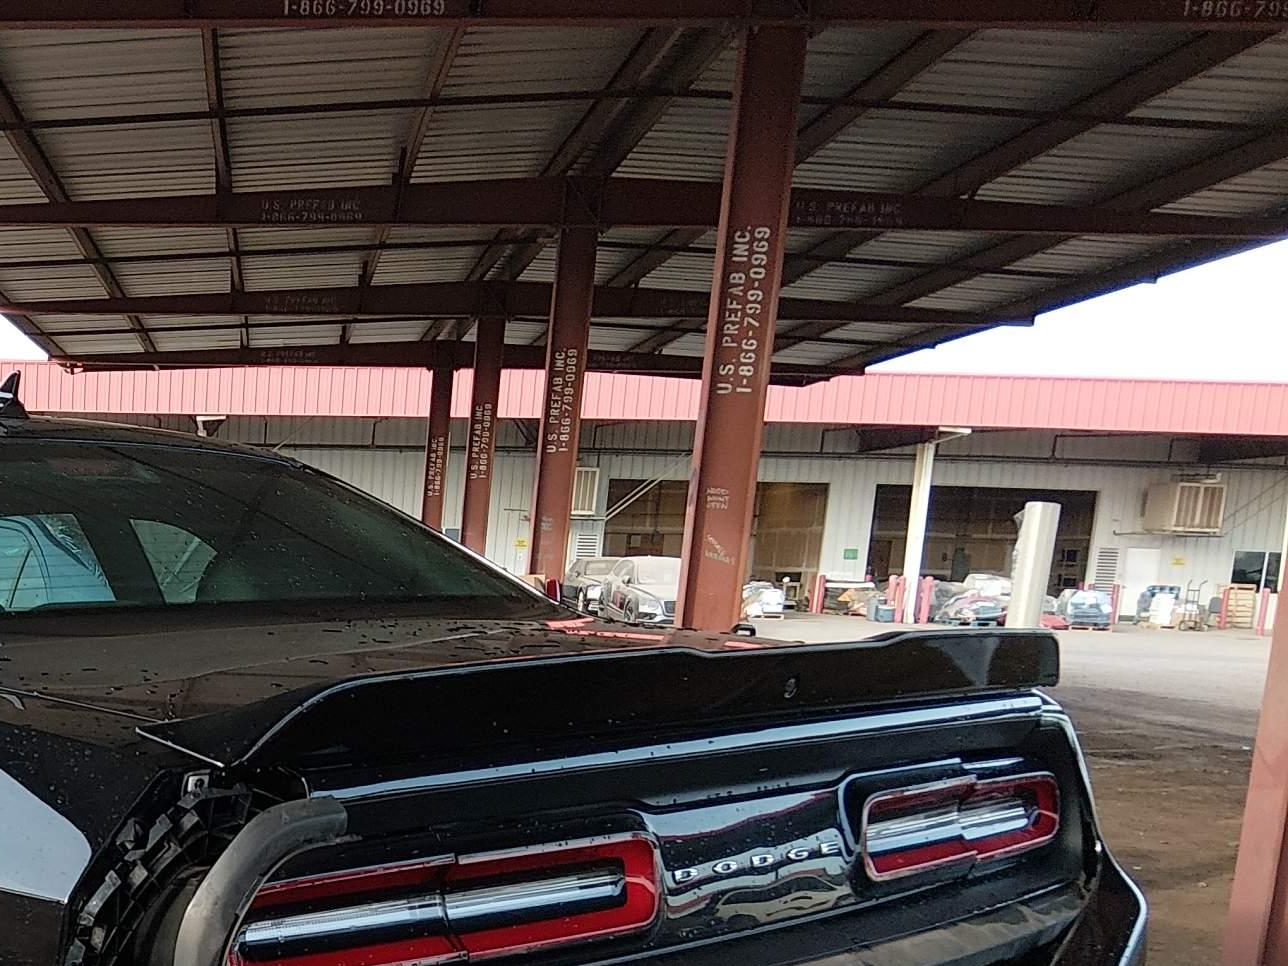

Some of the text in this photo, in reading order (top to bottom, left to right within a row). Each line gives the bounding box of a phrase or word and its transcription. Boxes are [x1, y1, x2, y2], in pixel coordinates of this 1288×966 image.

[283, 0, 446, 16] 1-866-799-0969
[717, 225, 752, 394] U.S. PREFAB INC.
[736, 226, 771, 394] 1-866-799-0969
[549, 377, 563, 424] PREFAB
[472, 423, 482, 458] PREFAB
[672, 842, 840, 883] DODGE
